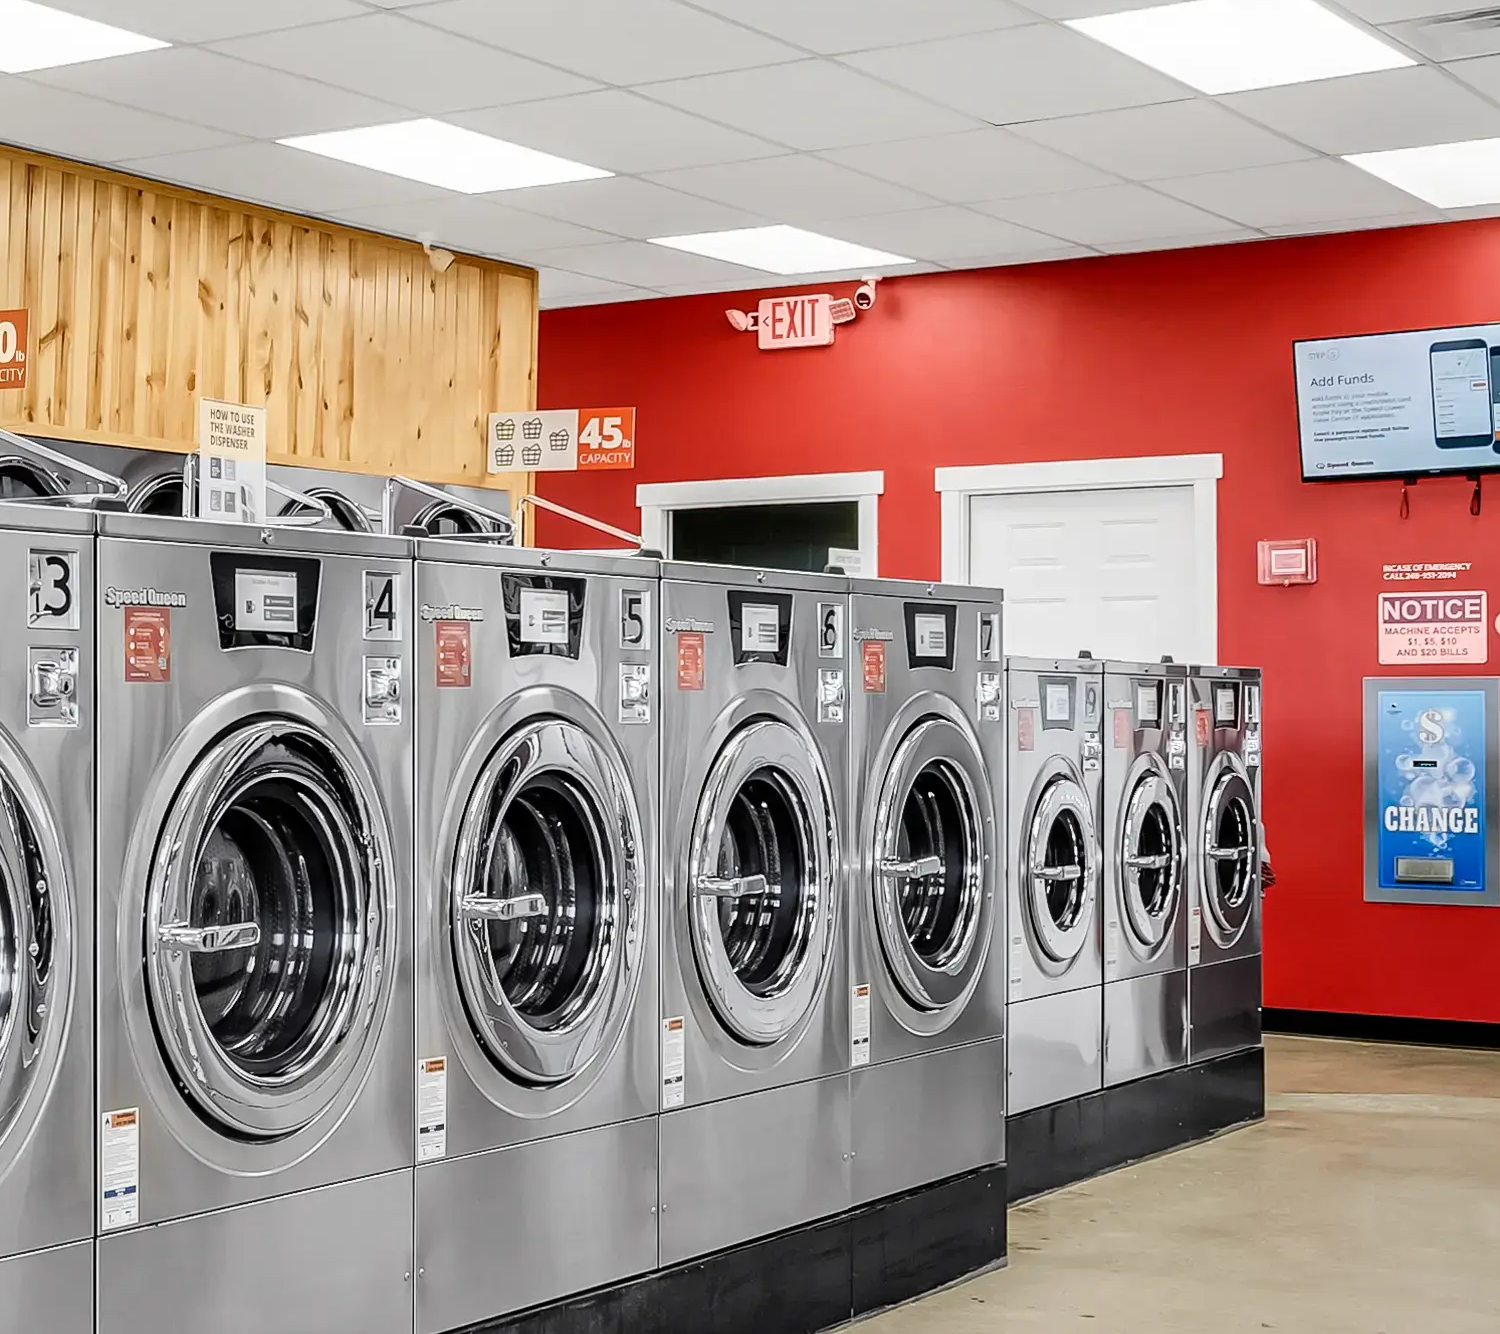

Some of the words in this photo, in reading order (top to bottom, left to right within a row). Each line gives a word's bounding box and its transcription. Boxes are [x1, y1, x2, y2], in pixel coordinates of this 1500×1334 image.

[771, 298, 819, 340] EXIT
[1310, 375, 1334, 388] Add
[1337, 372, 1375, 386] Funds
[210, 408, 229, 421] HOW
[230, 411, 240, 423] TO
[241, 413, 255, 425] USE
[209, 421, 224, 434] THE
[225, 424, 255, 438] WASHER
[210, 435, 249, 450] DISPENSER
[579, 452, 631, 465] CAPACITY
[43, 555, 73, 617] 3
[105, 585, 147, 609] Speed
[147, 587, 187, 608] Queen
[373, 578, 396, 632] 4
[1383, 597, 1482, 621] NOTICE
[626, 597, 644, 644] 5
[823, 609, 836, 650] 6
[1384, 627, 1430, 635] MACHINE
[1433, 626, 1480, 635] ACCEPTS
[1407, 637, 1421, 646] $1,
[1440, 637, 1457, 645] $10
[1396, 648, 1418, 657] AND
[1420, 648, 1437, 656] $20
[1439, 647, 1468, 656] BILLS
[1384, 804, 1479, 834] CHANGE
